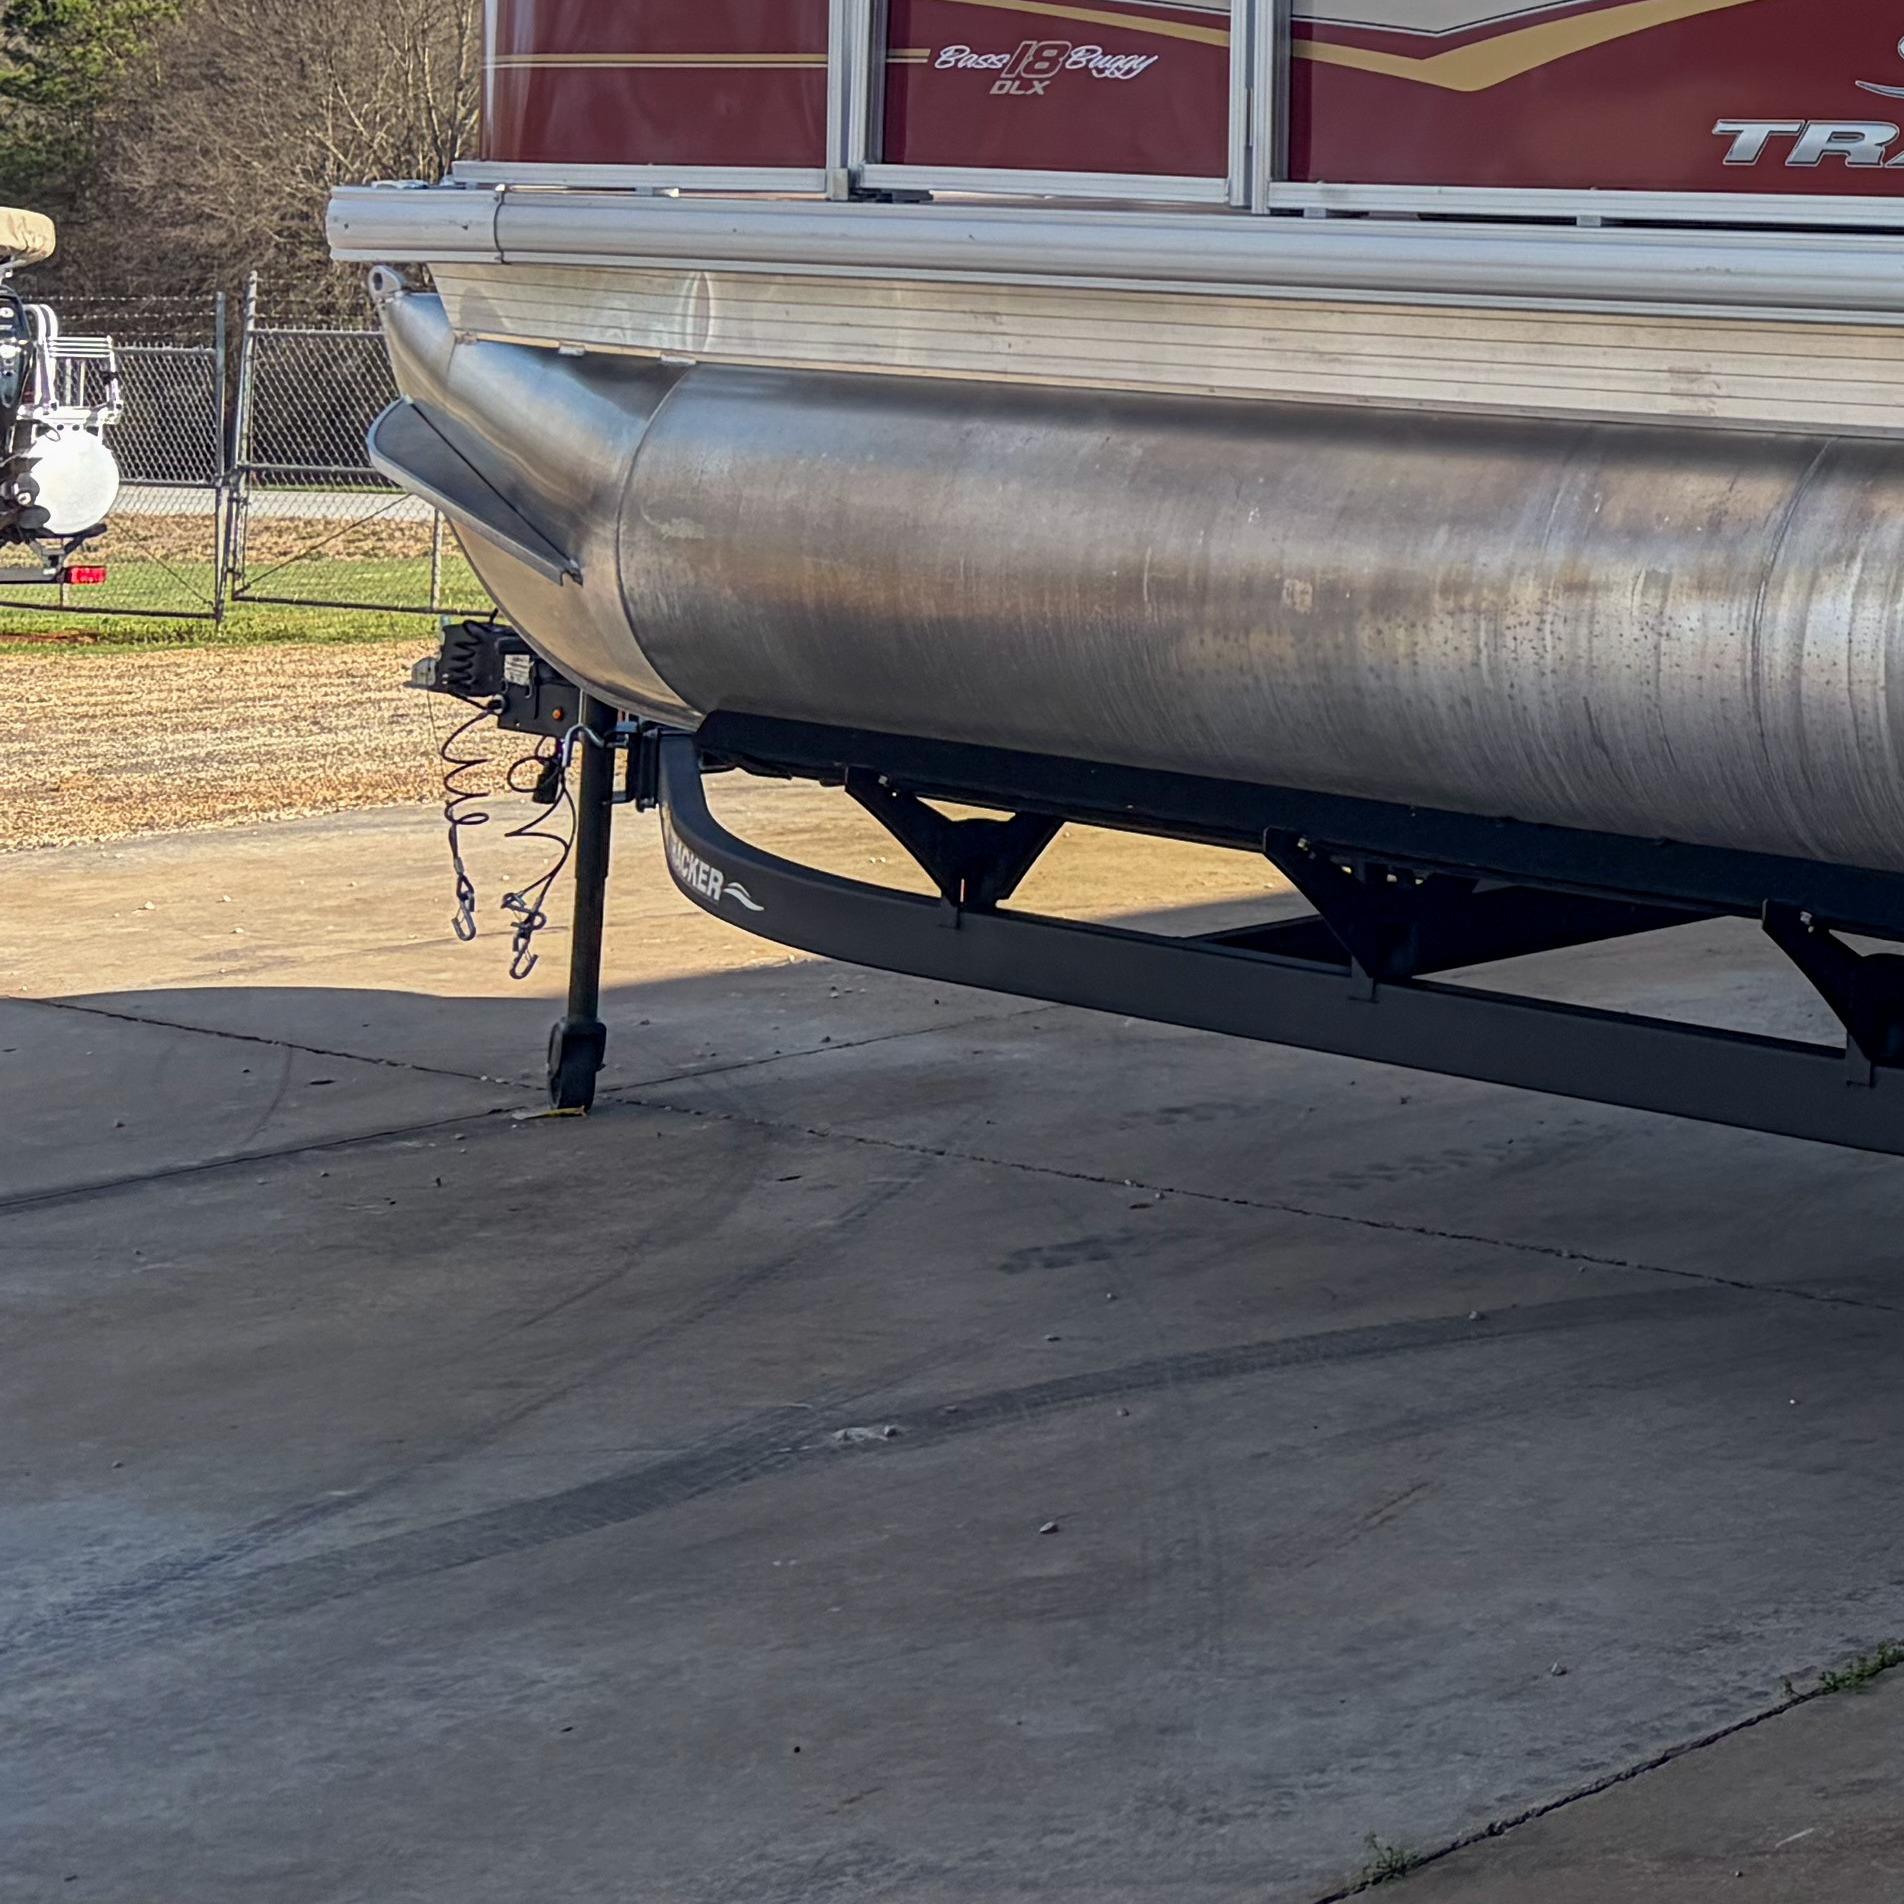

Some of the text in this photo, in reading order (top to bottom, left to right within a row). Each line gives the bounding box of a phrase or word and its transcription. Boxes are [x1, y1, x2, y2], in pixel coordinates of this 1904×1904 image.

[934, 40, 1159, 80] Bass 18 Buggy
[989, 80, 1051, 96] DLX
